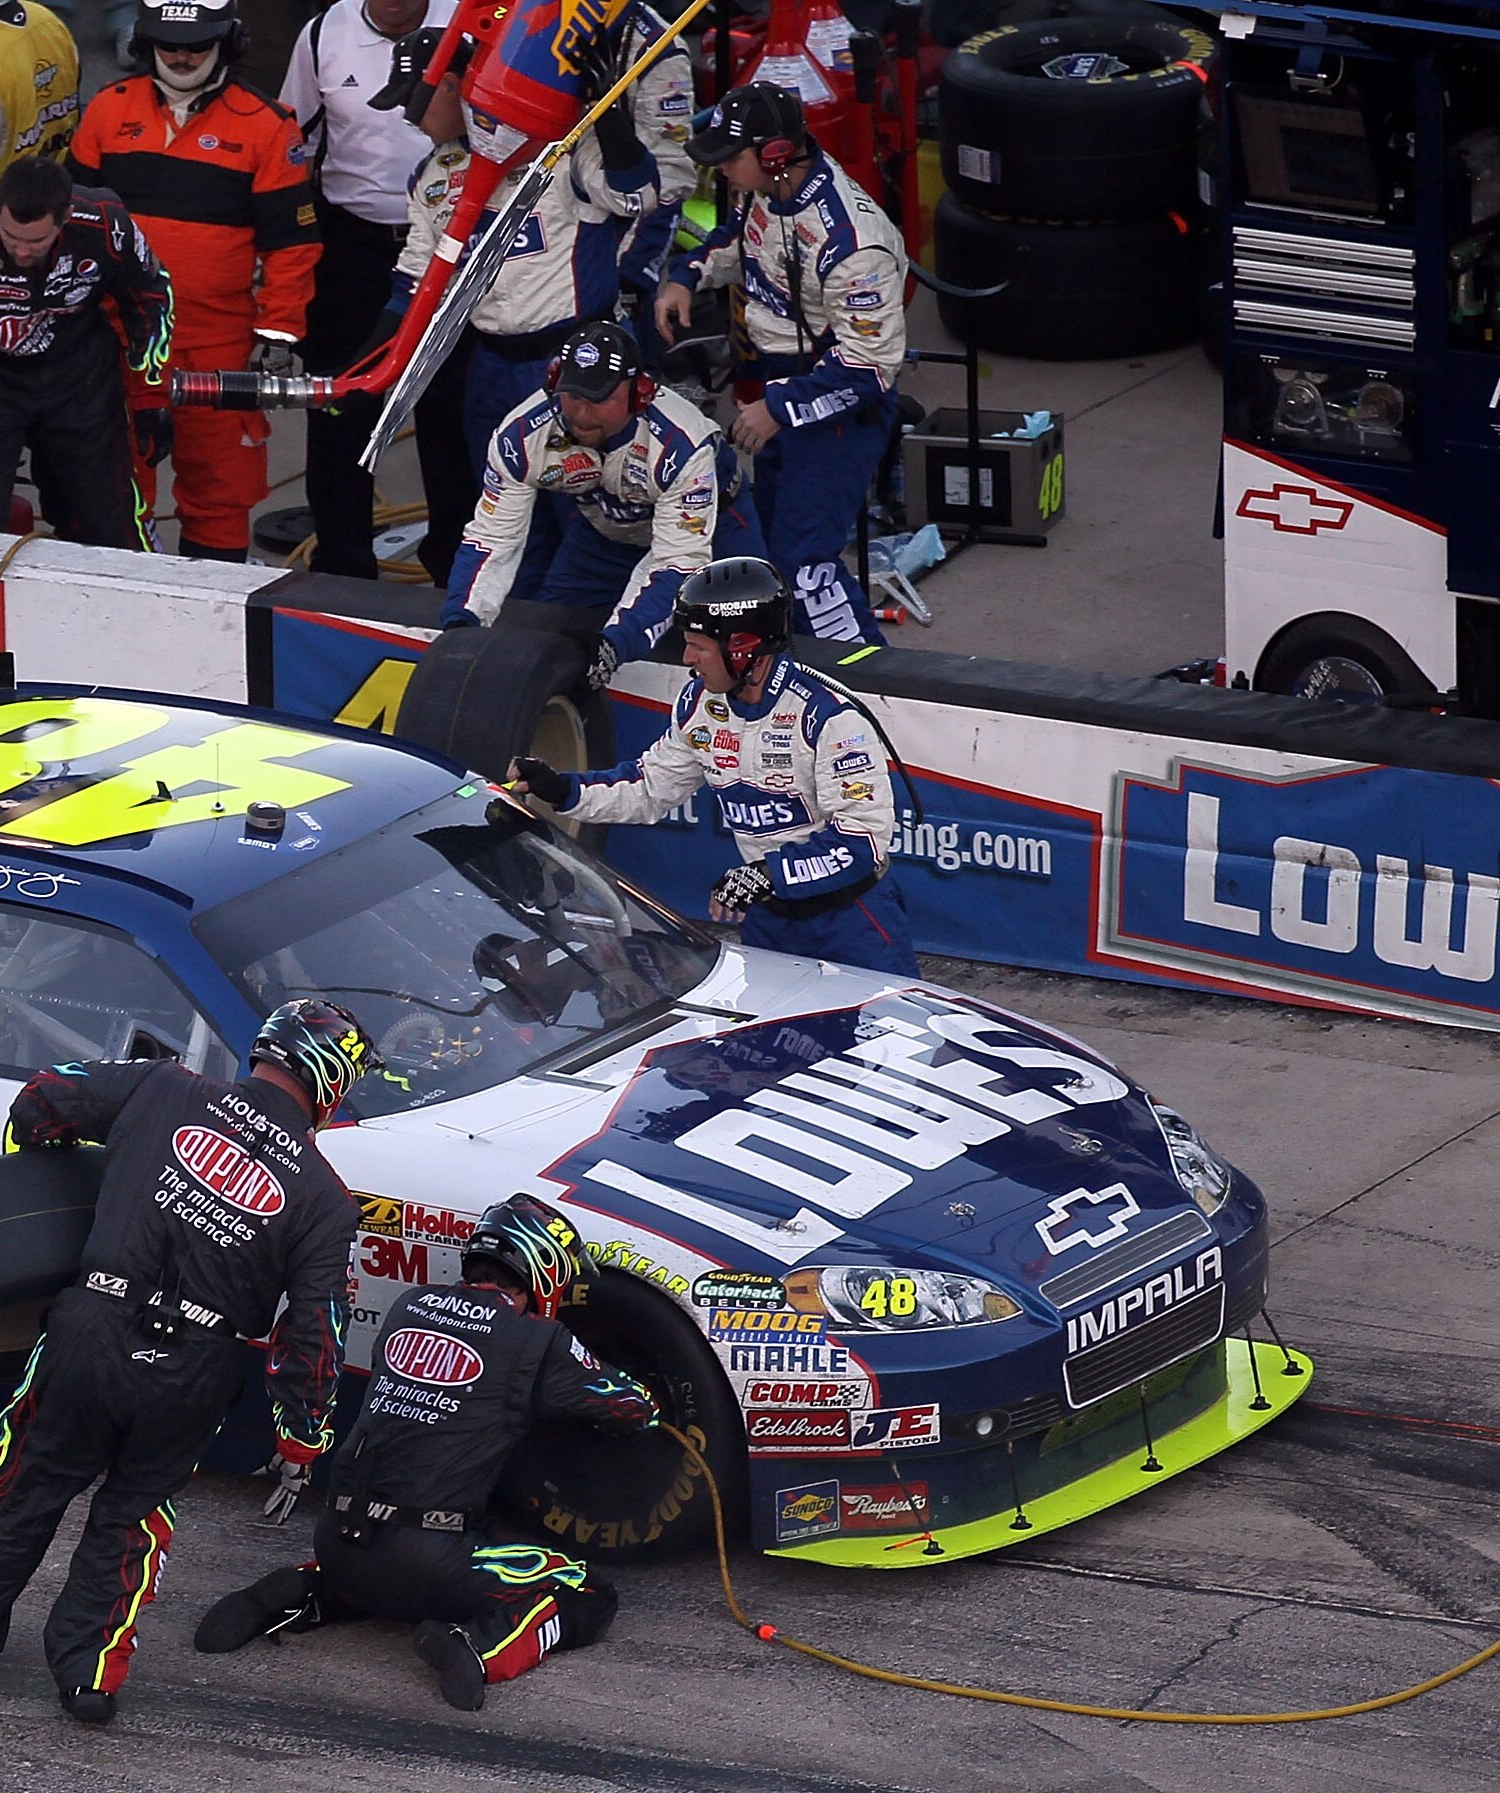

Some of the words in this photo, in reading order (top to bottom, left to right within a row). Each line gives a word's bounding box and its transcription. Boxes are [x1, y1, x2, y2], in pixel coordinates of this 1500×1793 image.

[162, 5, 198, 18] TEXAS
[1038, 452, 1063, 520] 48
[718, 599, 759, 613] KOBALT
[836, 754, 868, 771] LOWE'S
[779, 845, 856, 887] LOWE'S
[339, 1030, 366, 1062] 24
[205, 1100, 302, 1175] www.dupnt.com
[220, 1093, 304, 1158] HOUSTON
[583, 1012, 1130, 1267] LOWE'S
[177, 1130, 280, 1213] DUPONT
[153, 1188, 173, 1211] of
[172, 1200, 234, 1248] science
[157, 1164, 190, 1194] The
[186, 1183, 257, 1242] miracles
[370, 1224, 401, 1237] WEAR
[404, 1230, 422, 1240] HP
[546, 1217, 576, 1249] 24
[359, 1234, 430, 1286] 3M
[693, 1279, 785, 1301] Gatorback
[707, 1271, 773, 1285] GOODYEAR
[699, 1297, 780, 1310] BELTS
[860, 1279, 917, 1319] 48
[1065, 1245, 1224, 1354] IMPALA
[404, 1302, 493, 1335] www.dupont.com
[710, 1309, 826, 1333] MOOG
[778, 1332, 820, 1345] PARTS
[389, 1331, 477, 1382] DUPONT
[730, 1345, 848, 1373] MAHLE
[374, 1374, 396, 1395] The
[396, 1382, 461, 1414] miracles
[749, 1381, 840, 1404] COMP
[809, 1398, 853, 1408] CAMS
[369, 1394, 383, 1414] of
[381, 1398, 439, 1425] science
[749, 1416, 846, 1438] Edelbrock
[852, 1405, 935, 1448] JE
[877, 1435, 940, 1448] PISTONS
[781, 1496, 836, 1520] SUNOCO
